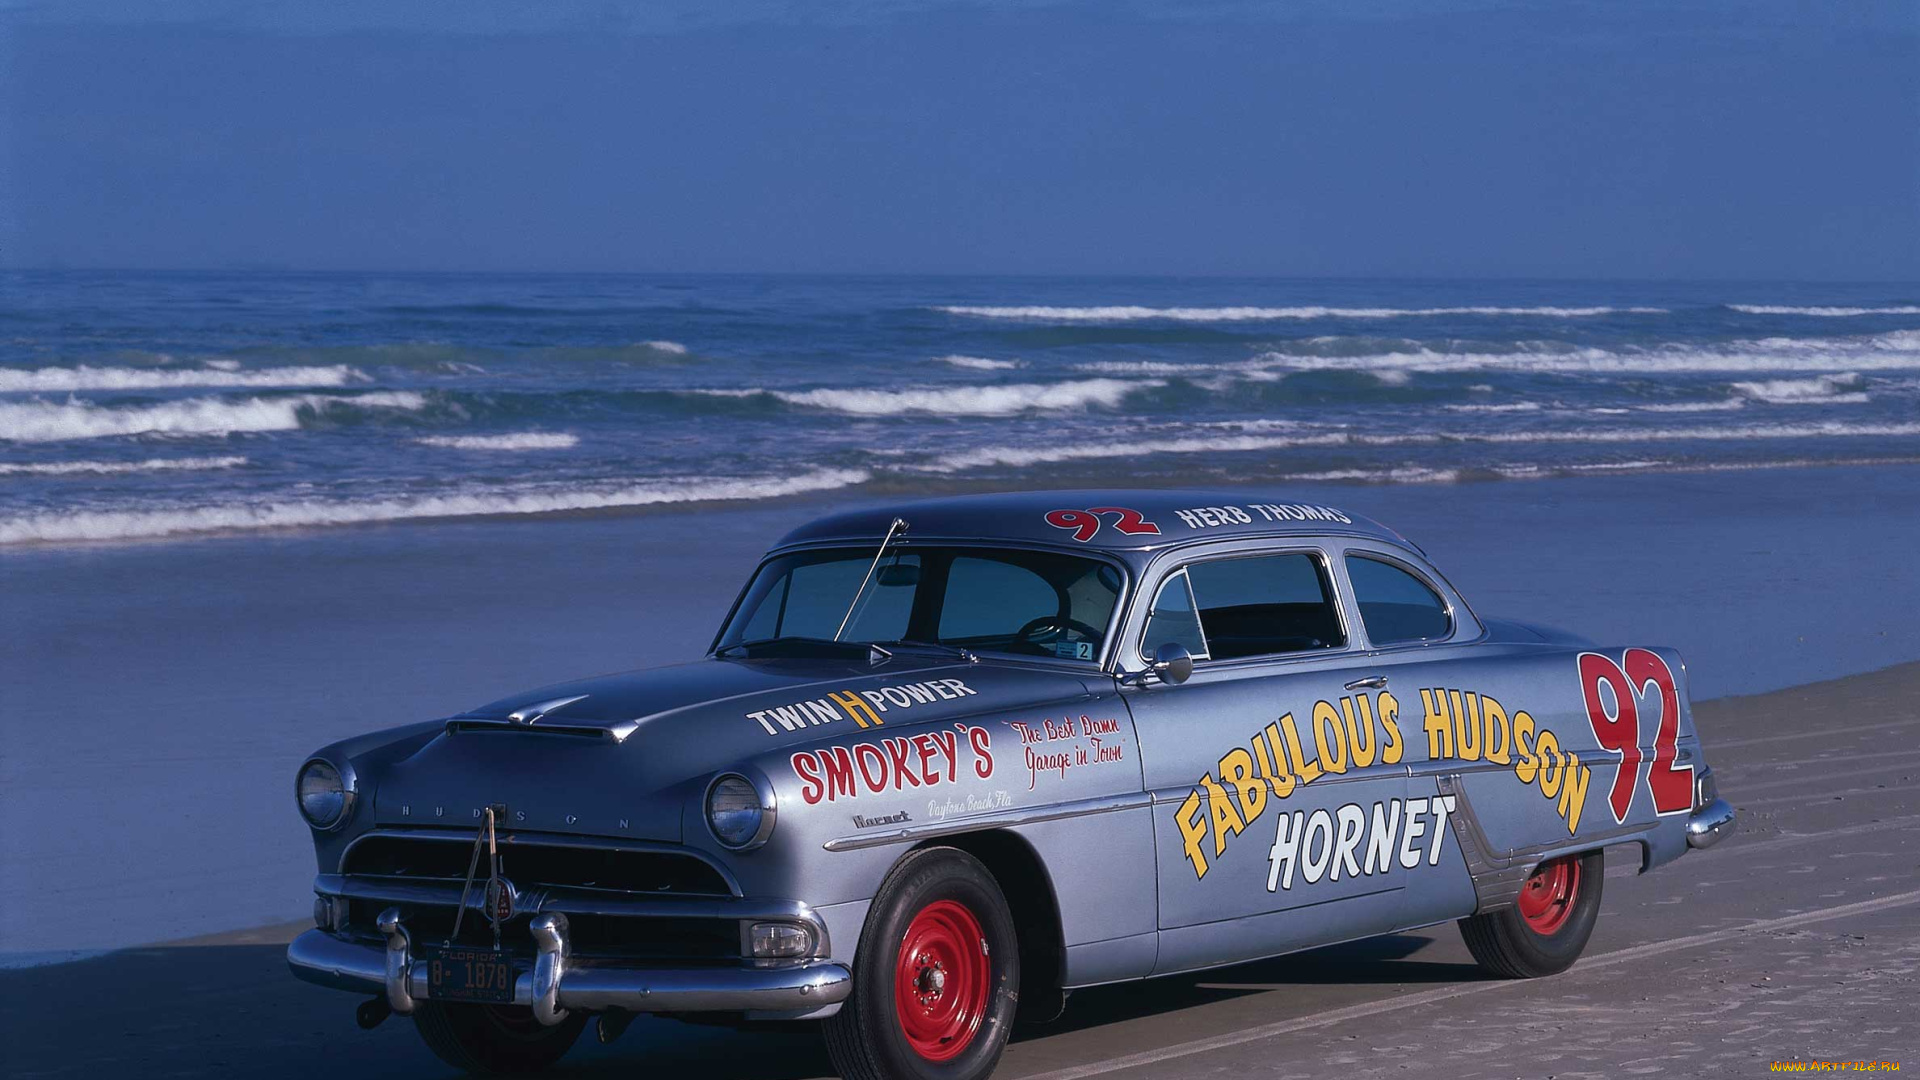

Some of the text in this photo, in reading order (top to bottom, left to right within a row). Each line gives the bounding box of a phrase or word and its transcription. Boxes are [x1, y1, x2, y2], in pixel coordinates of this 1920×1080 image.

[1045, 506, 1162, 542] 92
[1175, 503, 1352, 529] HERB THOMAS
[1080, 643, 1089, 658] 2
[746, 677, 978, 735] TWIN H POWER
[1043, 716, 1077, 742] Best
[1079, 714, 1121, 737] Damn
[1577, 647, 1695, 824] 92
[790, 722, 997, 806] SMOKEY'S
[1024, 746, 1073, 791] Garage
[1074, 744, 1089, 766] in
[1174, 687, 1592, 880] FABULOUS HUDSON
[402, 805, 630, 829] HUDSON
[853, 811, 912, 829] Hornet
[928, 800, 965, 820] Daytona
[1267, 795, 1456, 894] HORNET
[441, 951, 498, 962] FLORIDA
